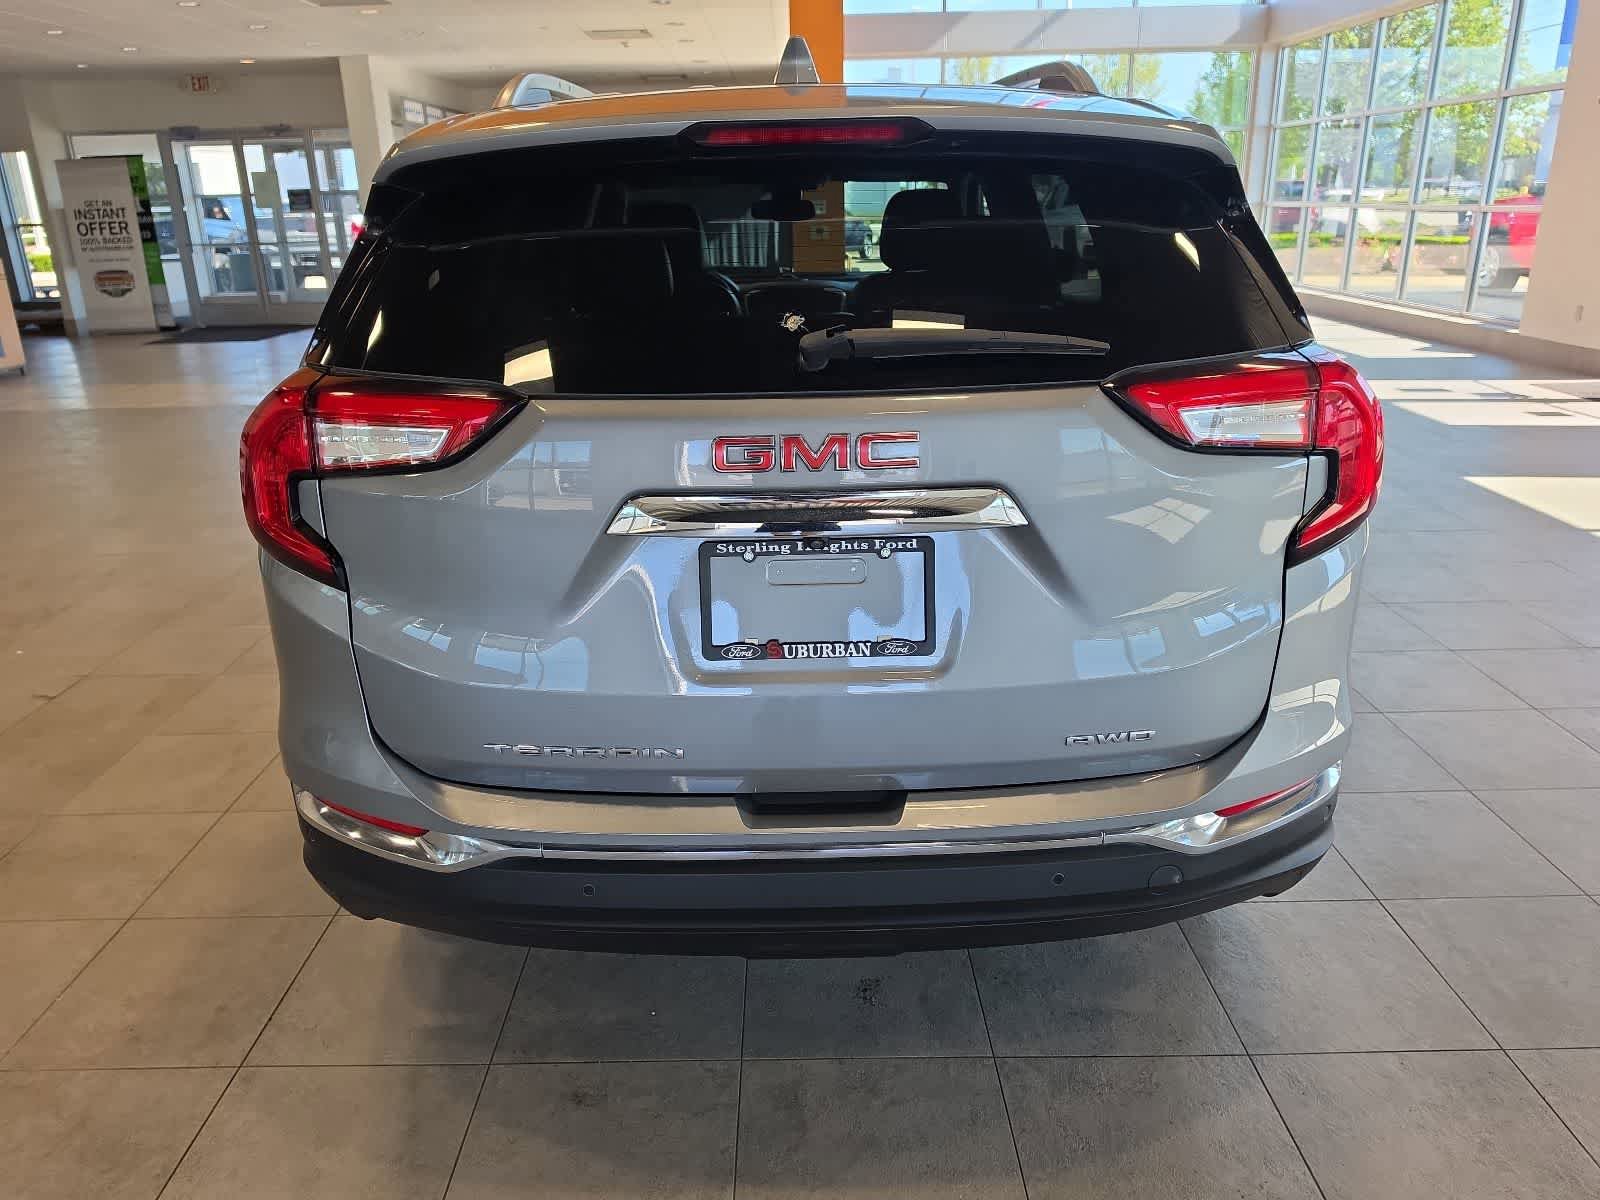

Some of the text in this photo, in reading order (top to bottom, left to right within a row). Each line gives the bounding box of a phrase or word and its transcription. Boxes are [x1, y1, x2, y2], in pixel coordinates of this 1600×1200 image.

[191, 75, 209, 91] EXIT
[73, 207, 126, 221] INSTANT
[76, 220, 130, 237] OFFER
[712, 431, 921, 473] GMC
[716, 538, 918, 554] Sterling Hghts Ford
[766, 639, 872, 660] SUBURBAN
[1065, 729, 1156, 746] AWD
[483, 742, 685, 760] TERRAIN
